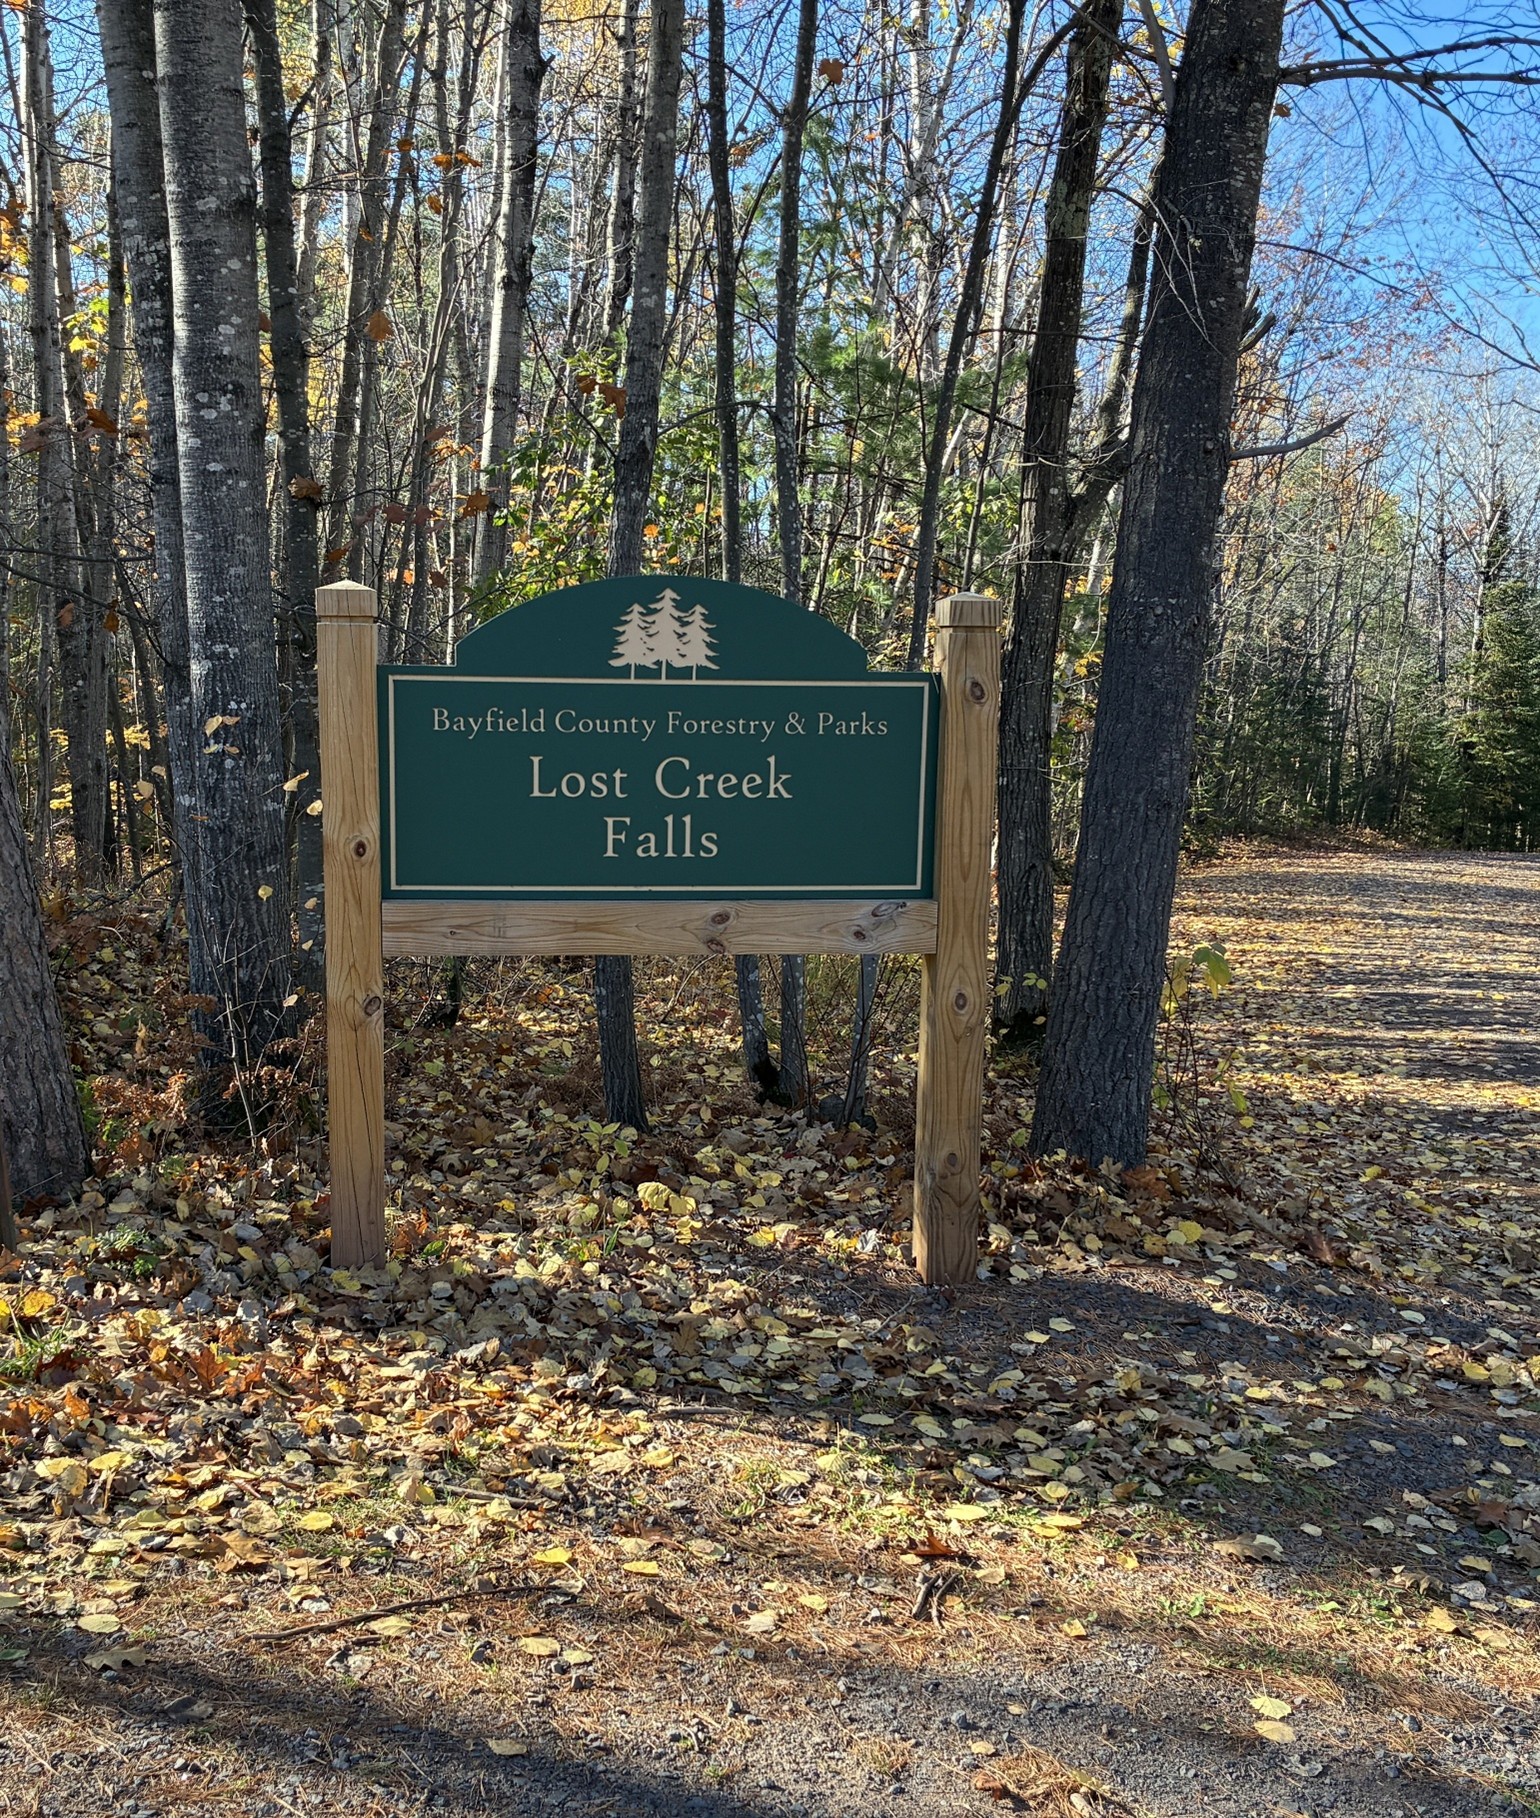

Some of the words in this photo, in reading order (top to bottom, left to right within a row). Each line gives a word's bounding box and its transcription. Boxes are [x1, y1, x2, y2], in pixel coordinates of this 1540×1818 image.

[433, 707, 545, 740] Bayfield
[555, 710, 656, 742] County
[668, 711, 775, 743] Forestry
[784, 712, 805, 735] &
[818, 711, 888, 735] Parks
[529, 756, 628, 798] Lost
[655, 755, 793, 799] Creek
[603, 814, 718, 858] Falls
